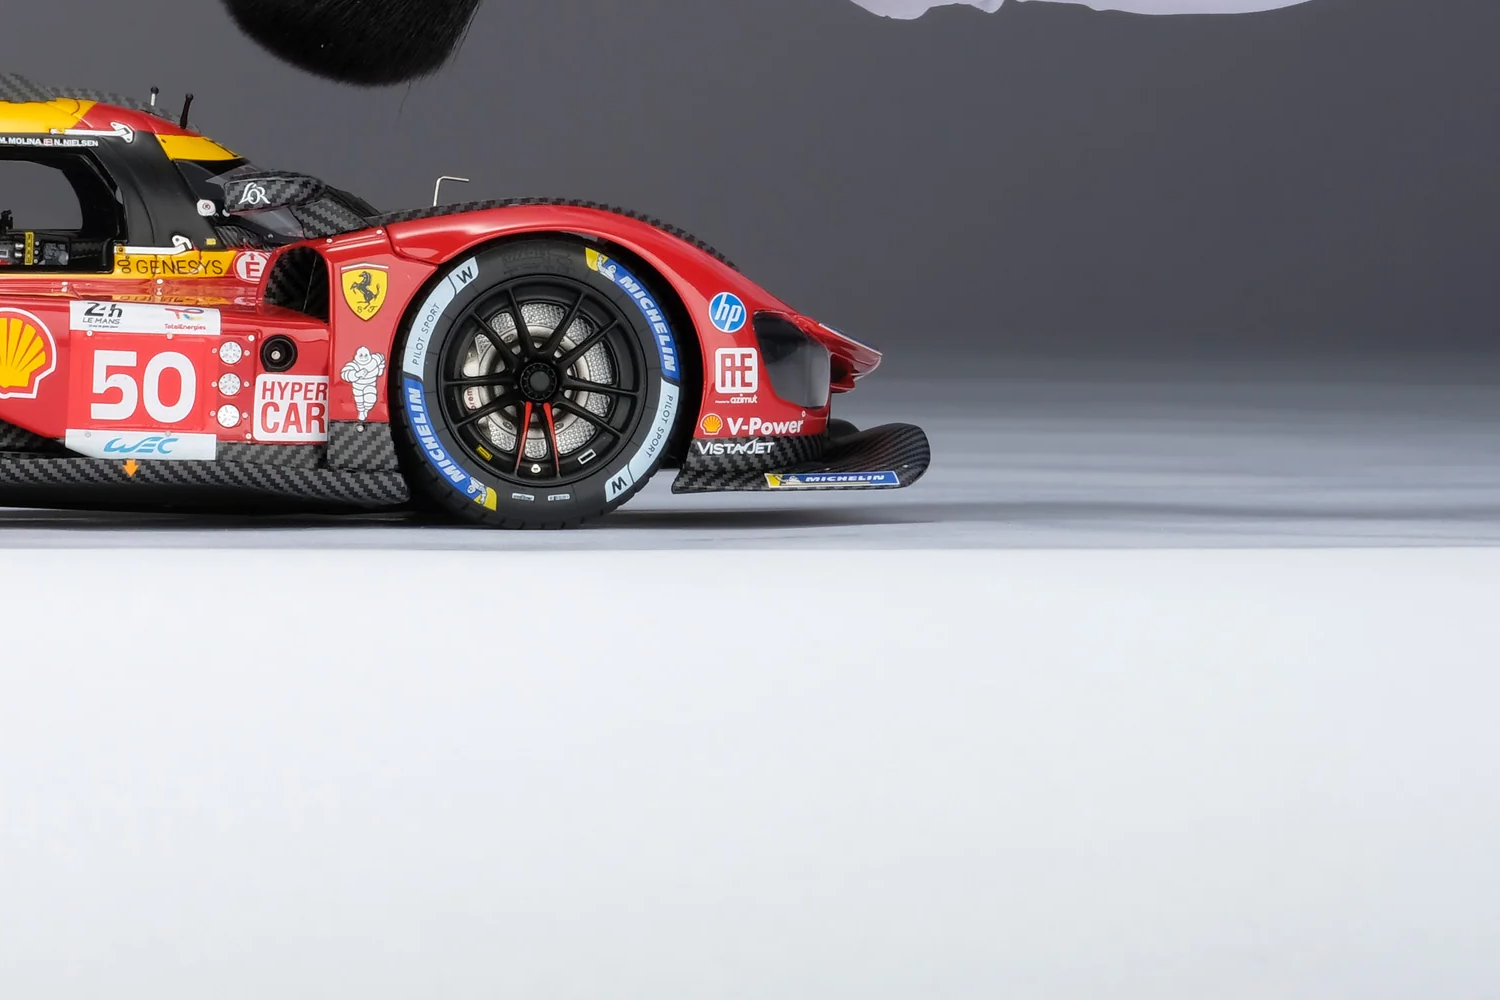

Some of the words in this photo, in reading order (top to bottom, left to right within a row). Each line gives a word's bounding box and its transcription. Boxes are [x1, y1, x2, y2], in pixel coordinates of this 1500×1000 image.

[8, 137, 42, 145] MOLINA
[135, 259, 223, 276] GENESYS
[95, 317, 121, 325] MANS
[716, 294, 740, 331] hp
[164, 323, 206, 331] TotalEnergies
[411, 336, 425, 366] PILOT
[420, 303, 441, 334] SPORT
[619, 276, 676, 373] MICHELIN
[90, 349, 196, 423] 50
[261, 380, 328, 401] HYPER
[730, 392, 758, 404] azimut
[260, 401, 326, 434] CAR
[661, 395, 674, 425] PILOT
[407, 388, 466, 485] MICHELIN
[727, 417, 804, 436] V-Power
[103, 436, 179, 455] WEC
[645, 426, 665, 459] SPORT
[697, 438, 775, 455] VISTAJET
[805, 474, 885, 482] MICHELIN
